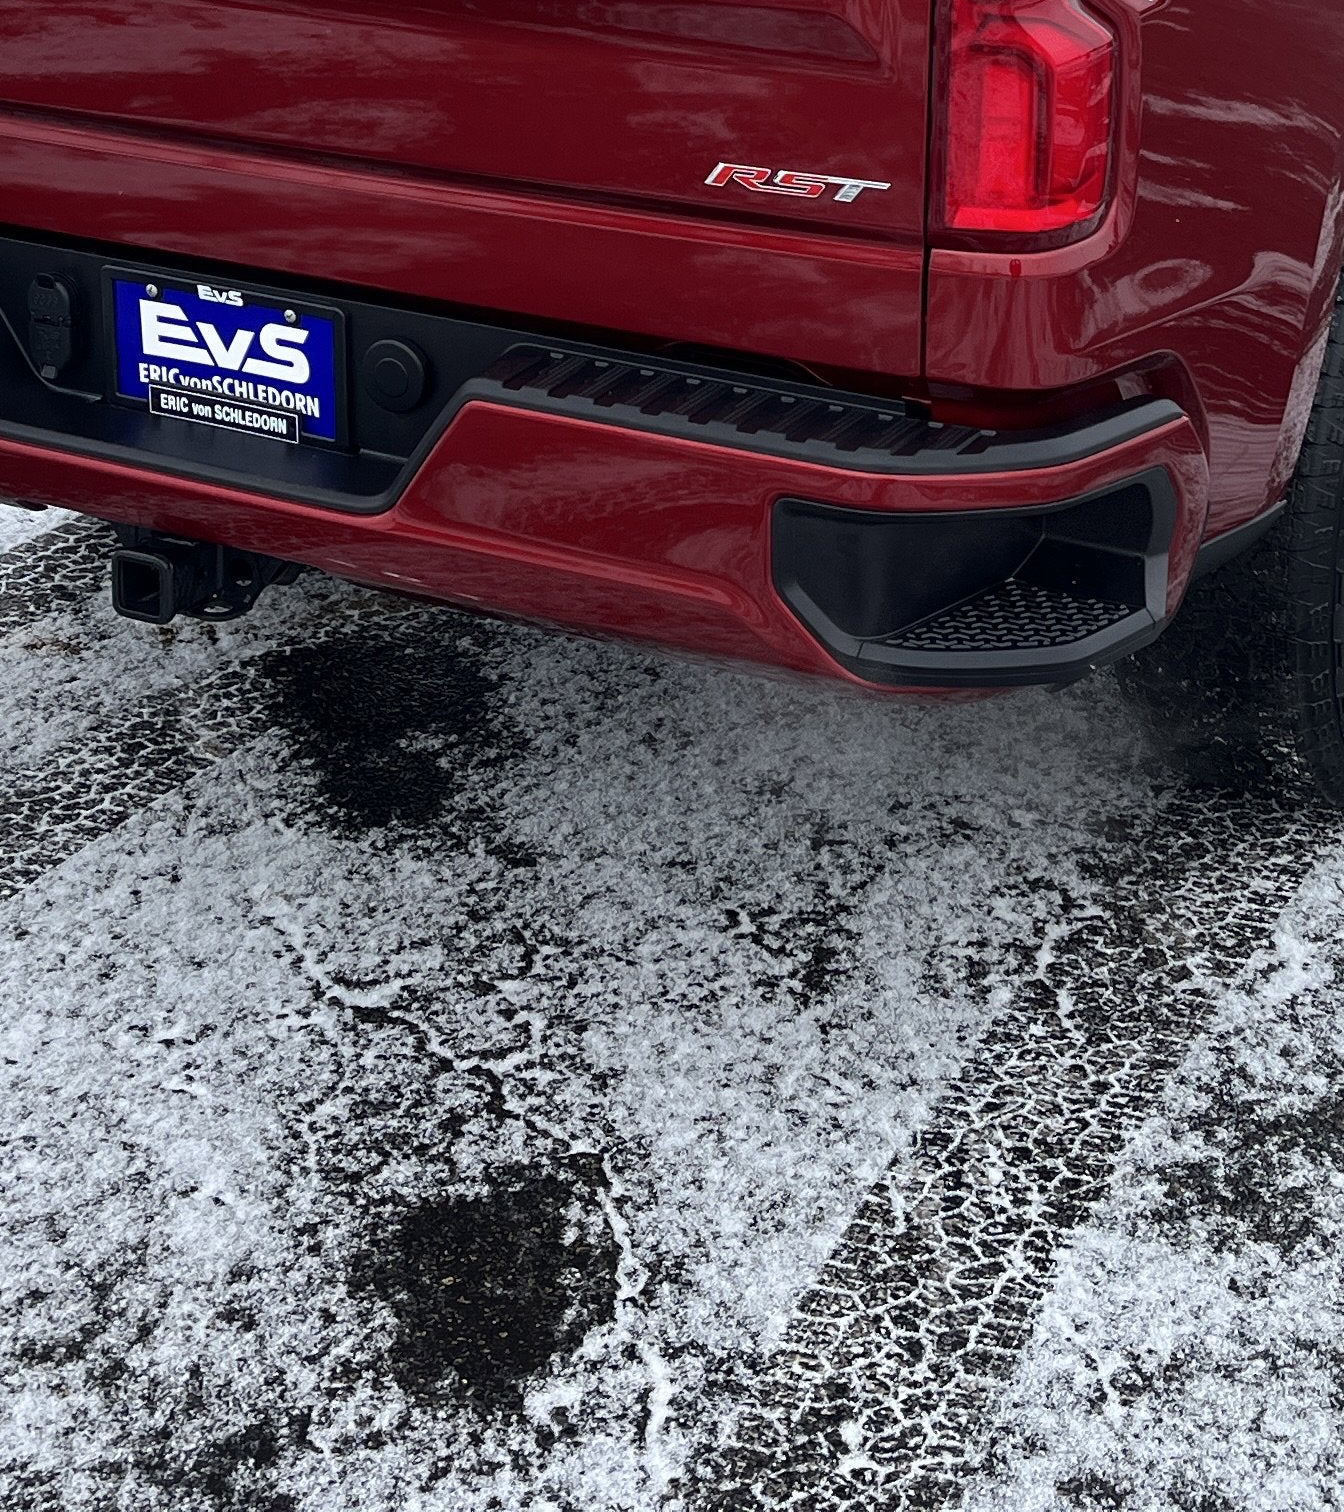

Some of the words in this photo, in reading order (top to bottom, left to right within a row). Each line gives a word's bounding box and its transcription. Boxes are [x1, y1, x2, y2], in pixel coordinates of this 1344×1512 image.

[704, 162, 891, 203] RST
[160, 393, 189, 413] ERIC
[192, 402, 212, 419] von
[214, 405, 287, 435] SCHLEDORN
